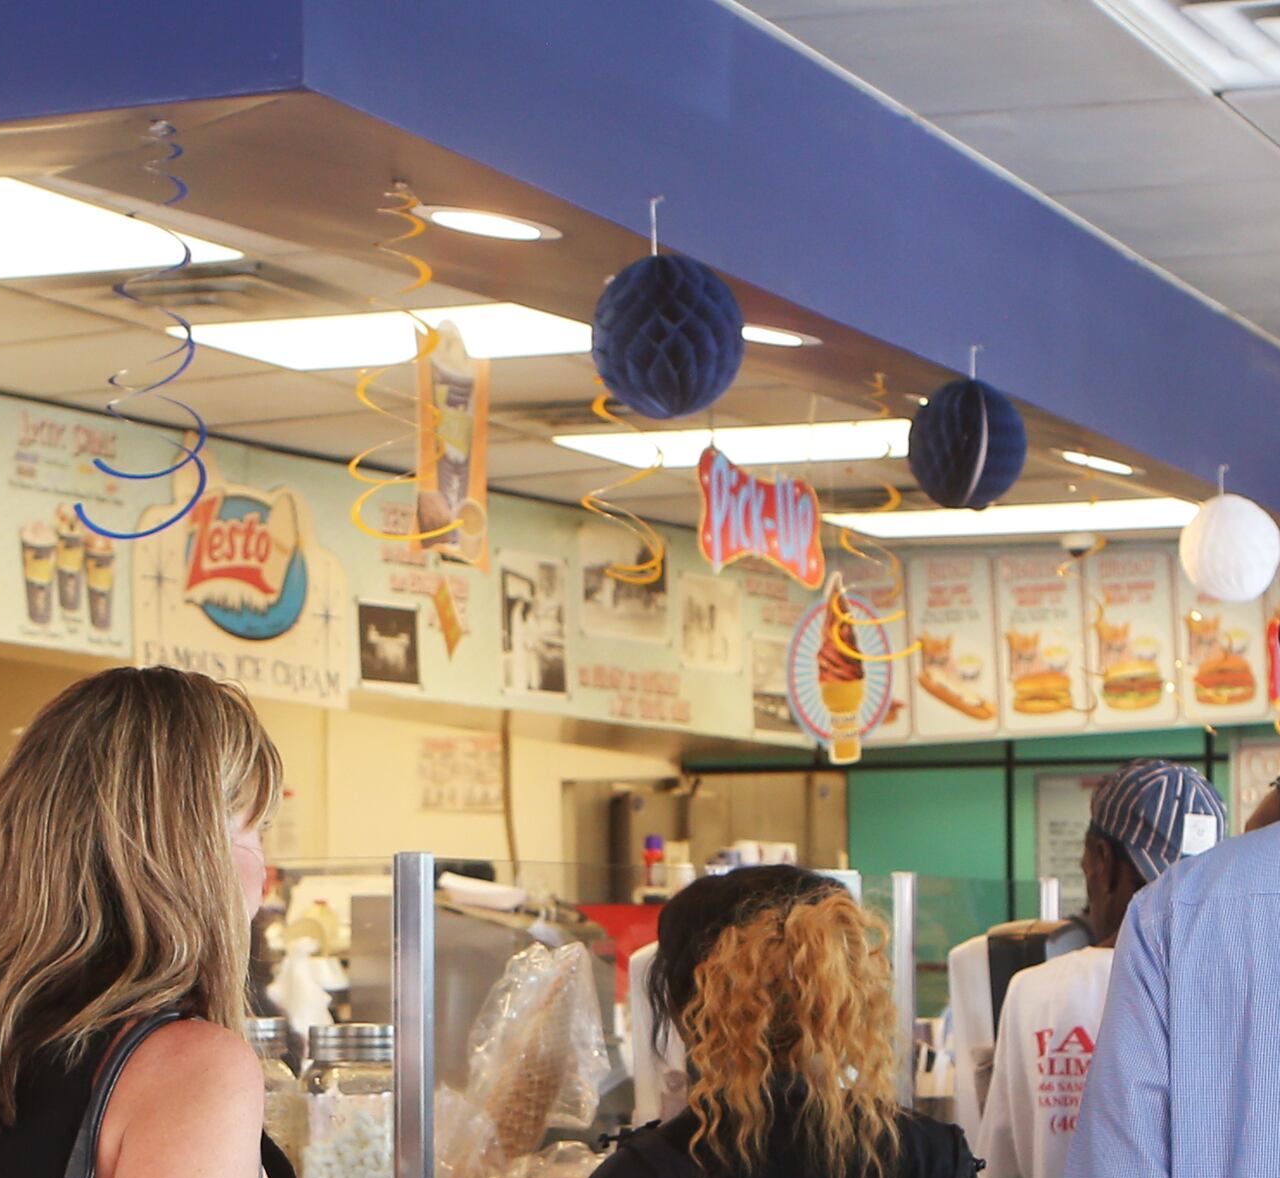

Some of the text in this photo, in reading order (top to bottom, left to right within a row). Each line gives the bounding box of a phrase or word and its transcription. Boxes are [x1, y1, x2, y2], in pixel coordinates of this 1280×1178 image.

[184, 494, 278, 594] Zesto
[143, 640, 341, 700] FAMOUS ICE CREAM
